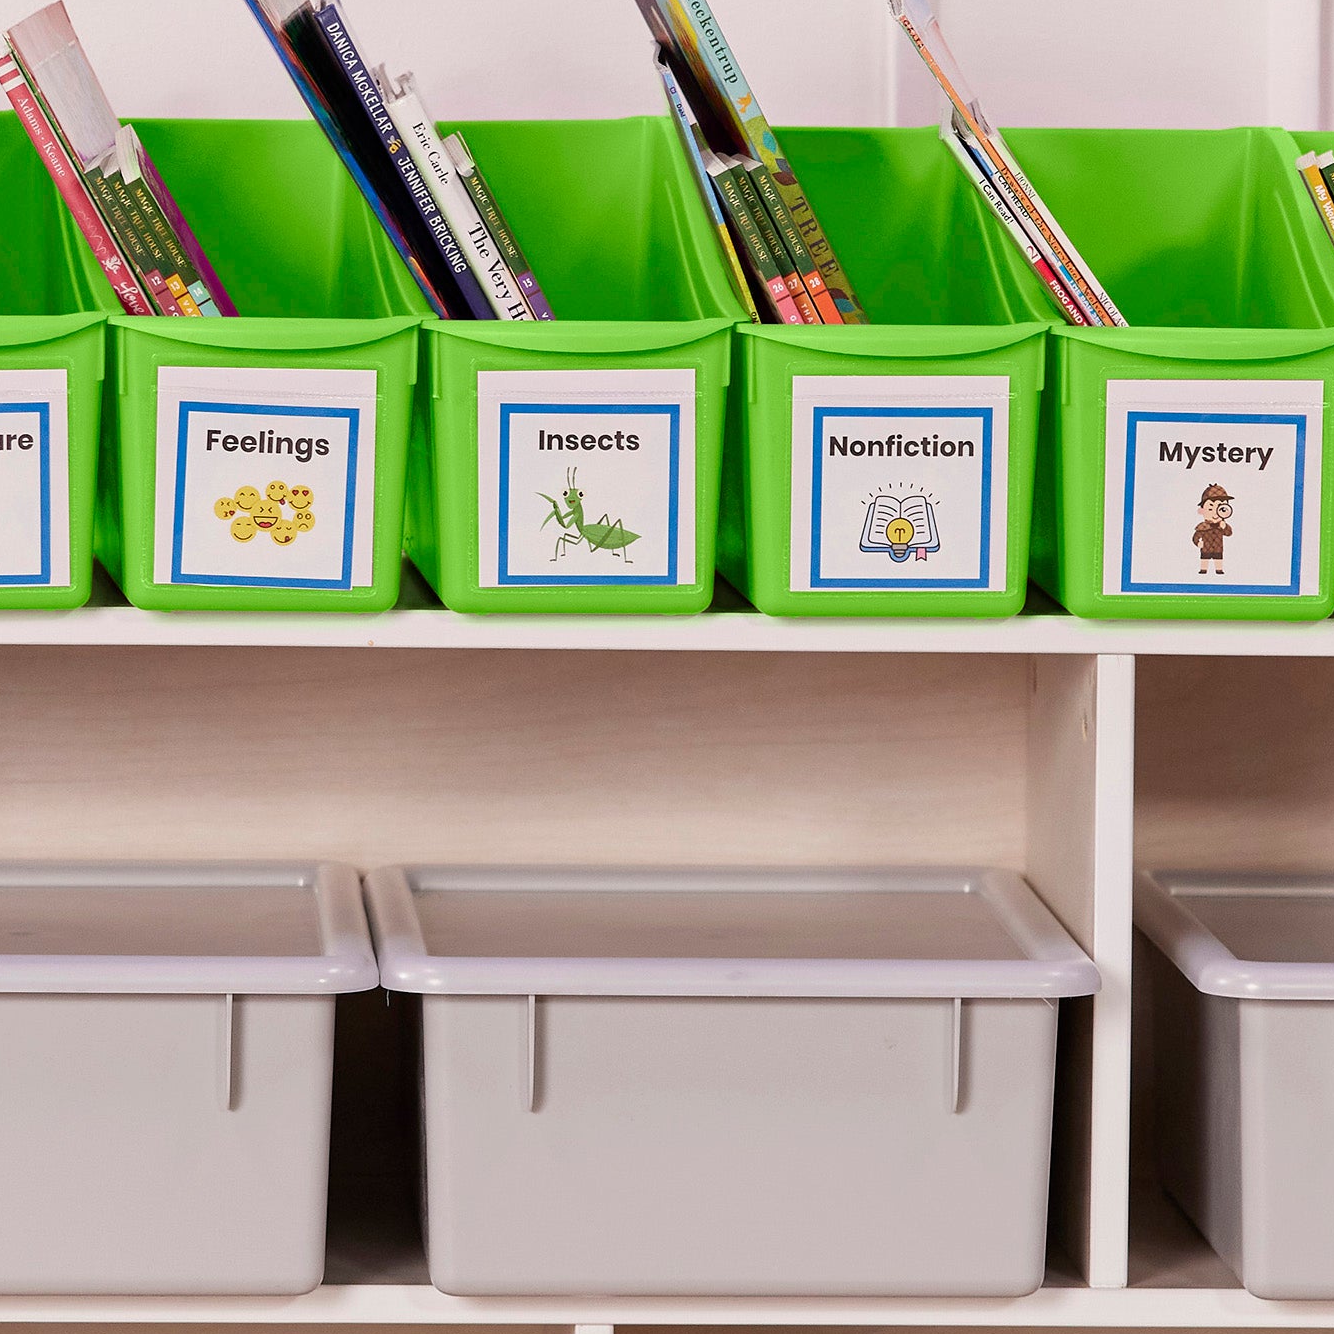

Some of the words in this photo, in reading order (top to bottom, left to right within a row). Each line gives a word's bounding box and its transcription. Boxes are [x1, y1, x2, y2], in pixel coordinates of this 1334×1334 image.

[17, 97, 43, 136] Adams
[42, 140, 66, 178] Keane
[327, 22, 358, 70] DANICA
[397, 155, 436, 216] JENNIFER
[429, 215, 467, 274] BRICKING
[413, 122, 431, 150] Eric
[428, 151, 449, 186] Carle
[95, 177, 114, 204] MAGIC
[114, 181, 133, 209] MAGIC
[470, 177, 488, 206] MAGIC
[723, 181, 741, 211] MAGIC
[758, 175, 778, 204] MAGIC
[998, 175, 1012, 194] CAN
[1315, 185, 1327, 202] My
[135, 188, 155, 217] MAGIC
[983, 184, 995, 201] Can
[994, 200, 1014, 225] Read!
[790, 195, 840, 279] TREE
[468, 222, 490, 259] The
[488, 259, 512, 301] Very
[151, 276, 162, 286] 12
[522, 279, 533, 288] 15
[772, 284, 784, 294] 26
[787, 278, 798, 290] 27
[809, 277, 821, 288] 28
[114, 281, 146, 315] Love
[1049, 280, 1070, 304] FROG
[1066, 303, 1083, 324] AND
[205, 429, 331, 463] Feelings
[538, 429, 640, 452] Insects
[829, 434, 975, 458] Nonfiction
[1158, 440, 1274, 471] Mystery
